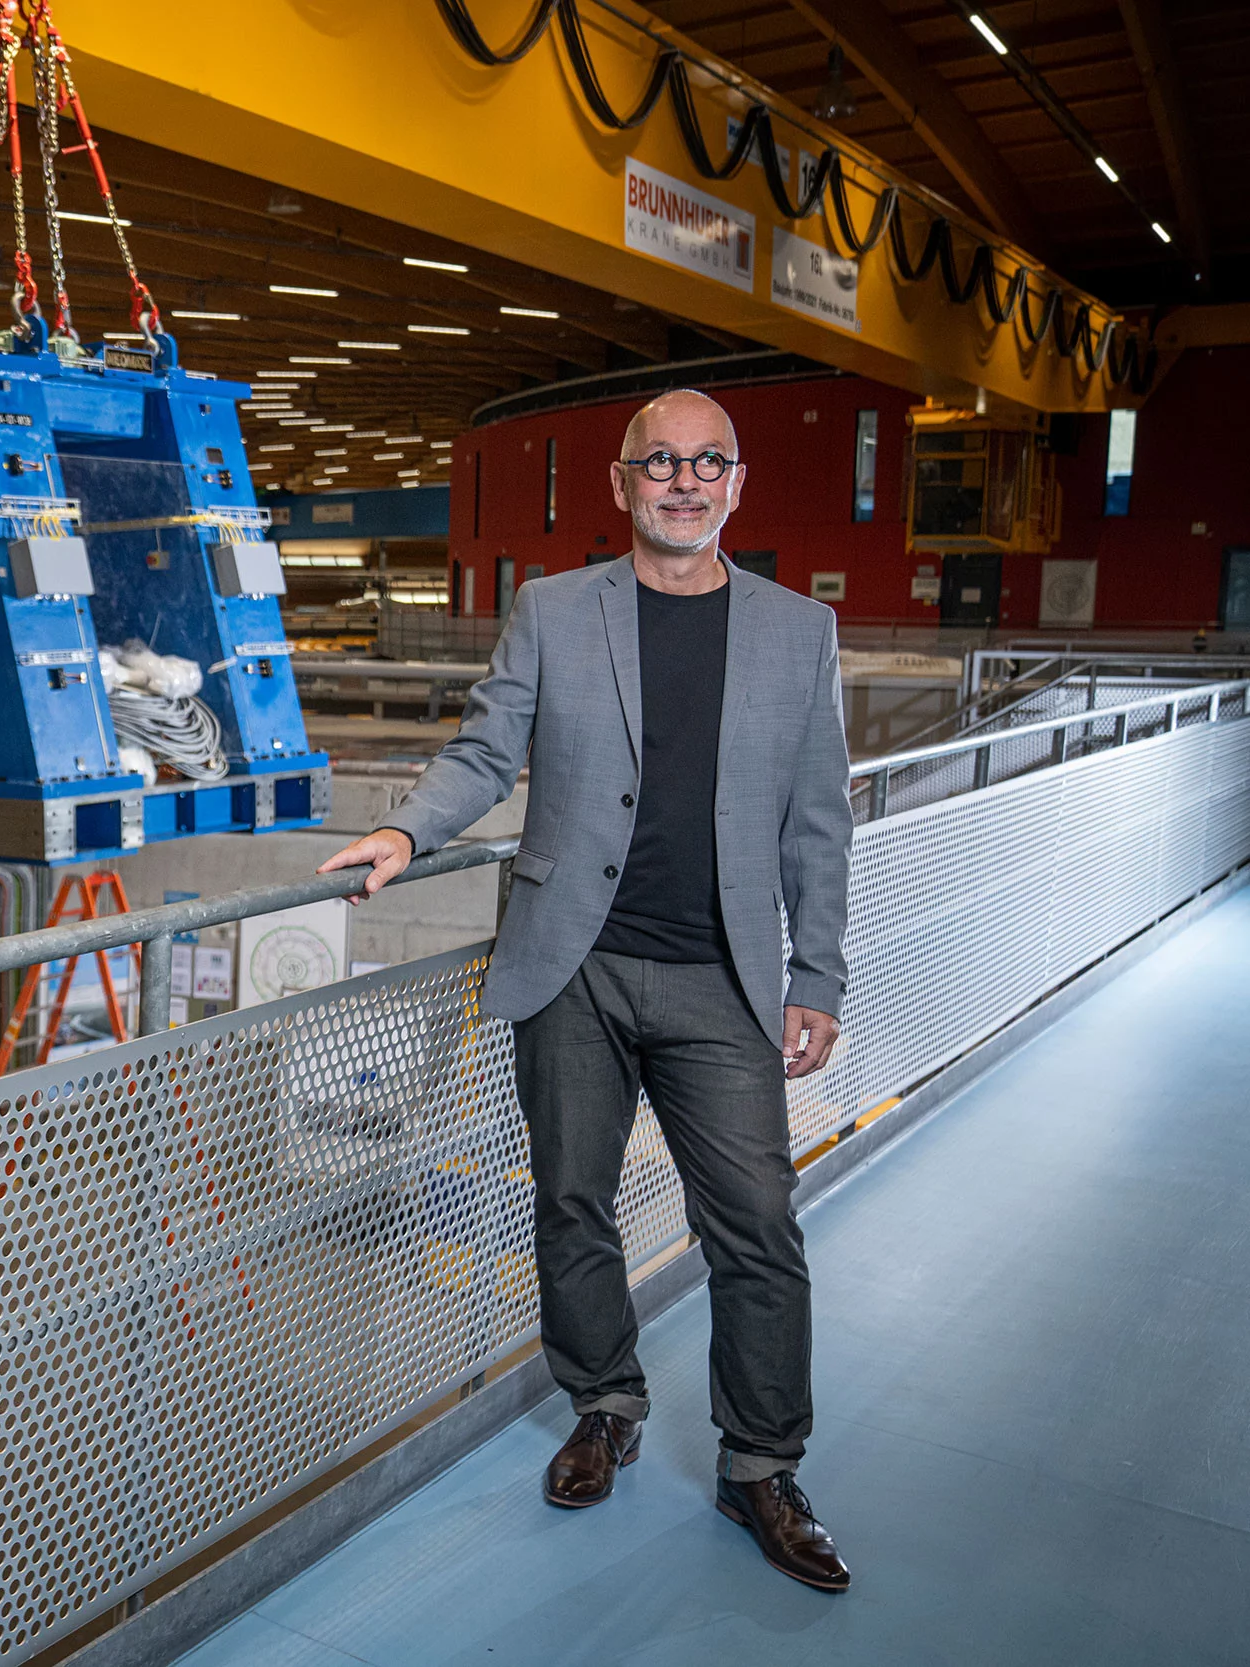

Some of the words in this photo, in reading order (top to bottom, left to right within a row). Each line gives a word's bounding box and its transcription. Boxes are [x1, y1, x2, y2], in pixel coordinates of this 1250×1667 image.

[628, 173, 729, 246] BRUNNHUBER
[628, 218, 681, 252] KRANE
[689, 243, 729, 270] GMBH
